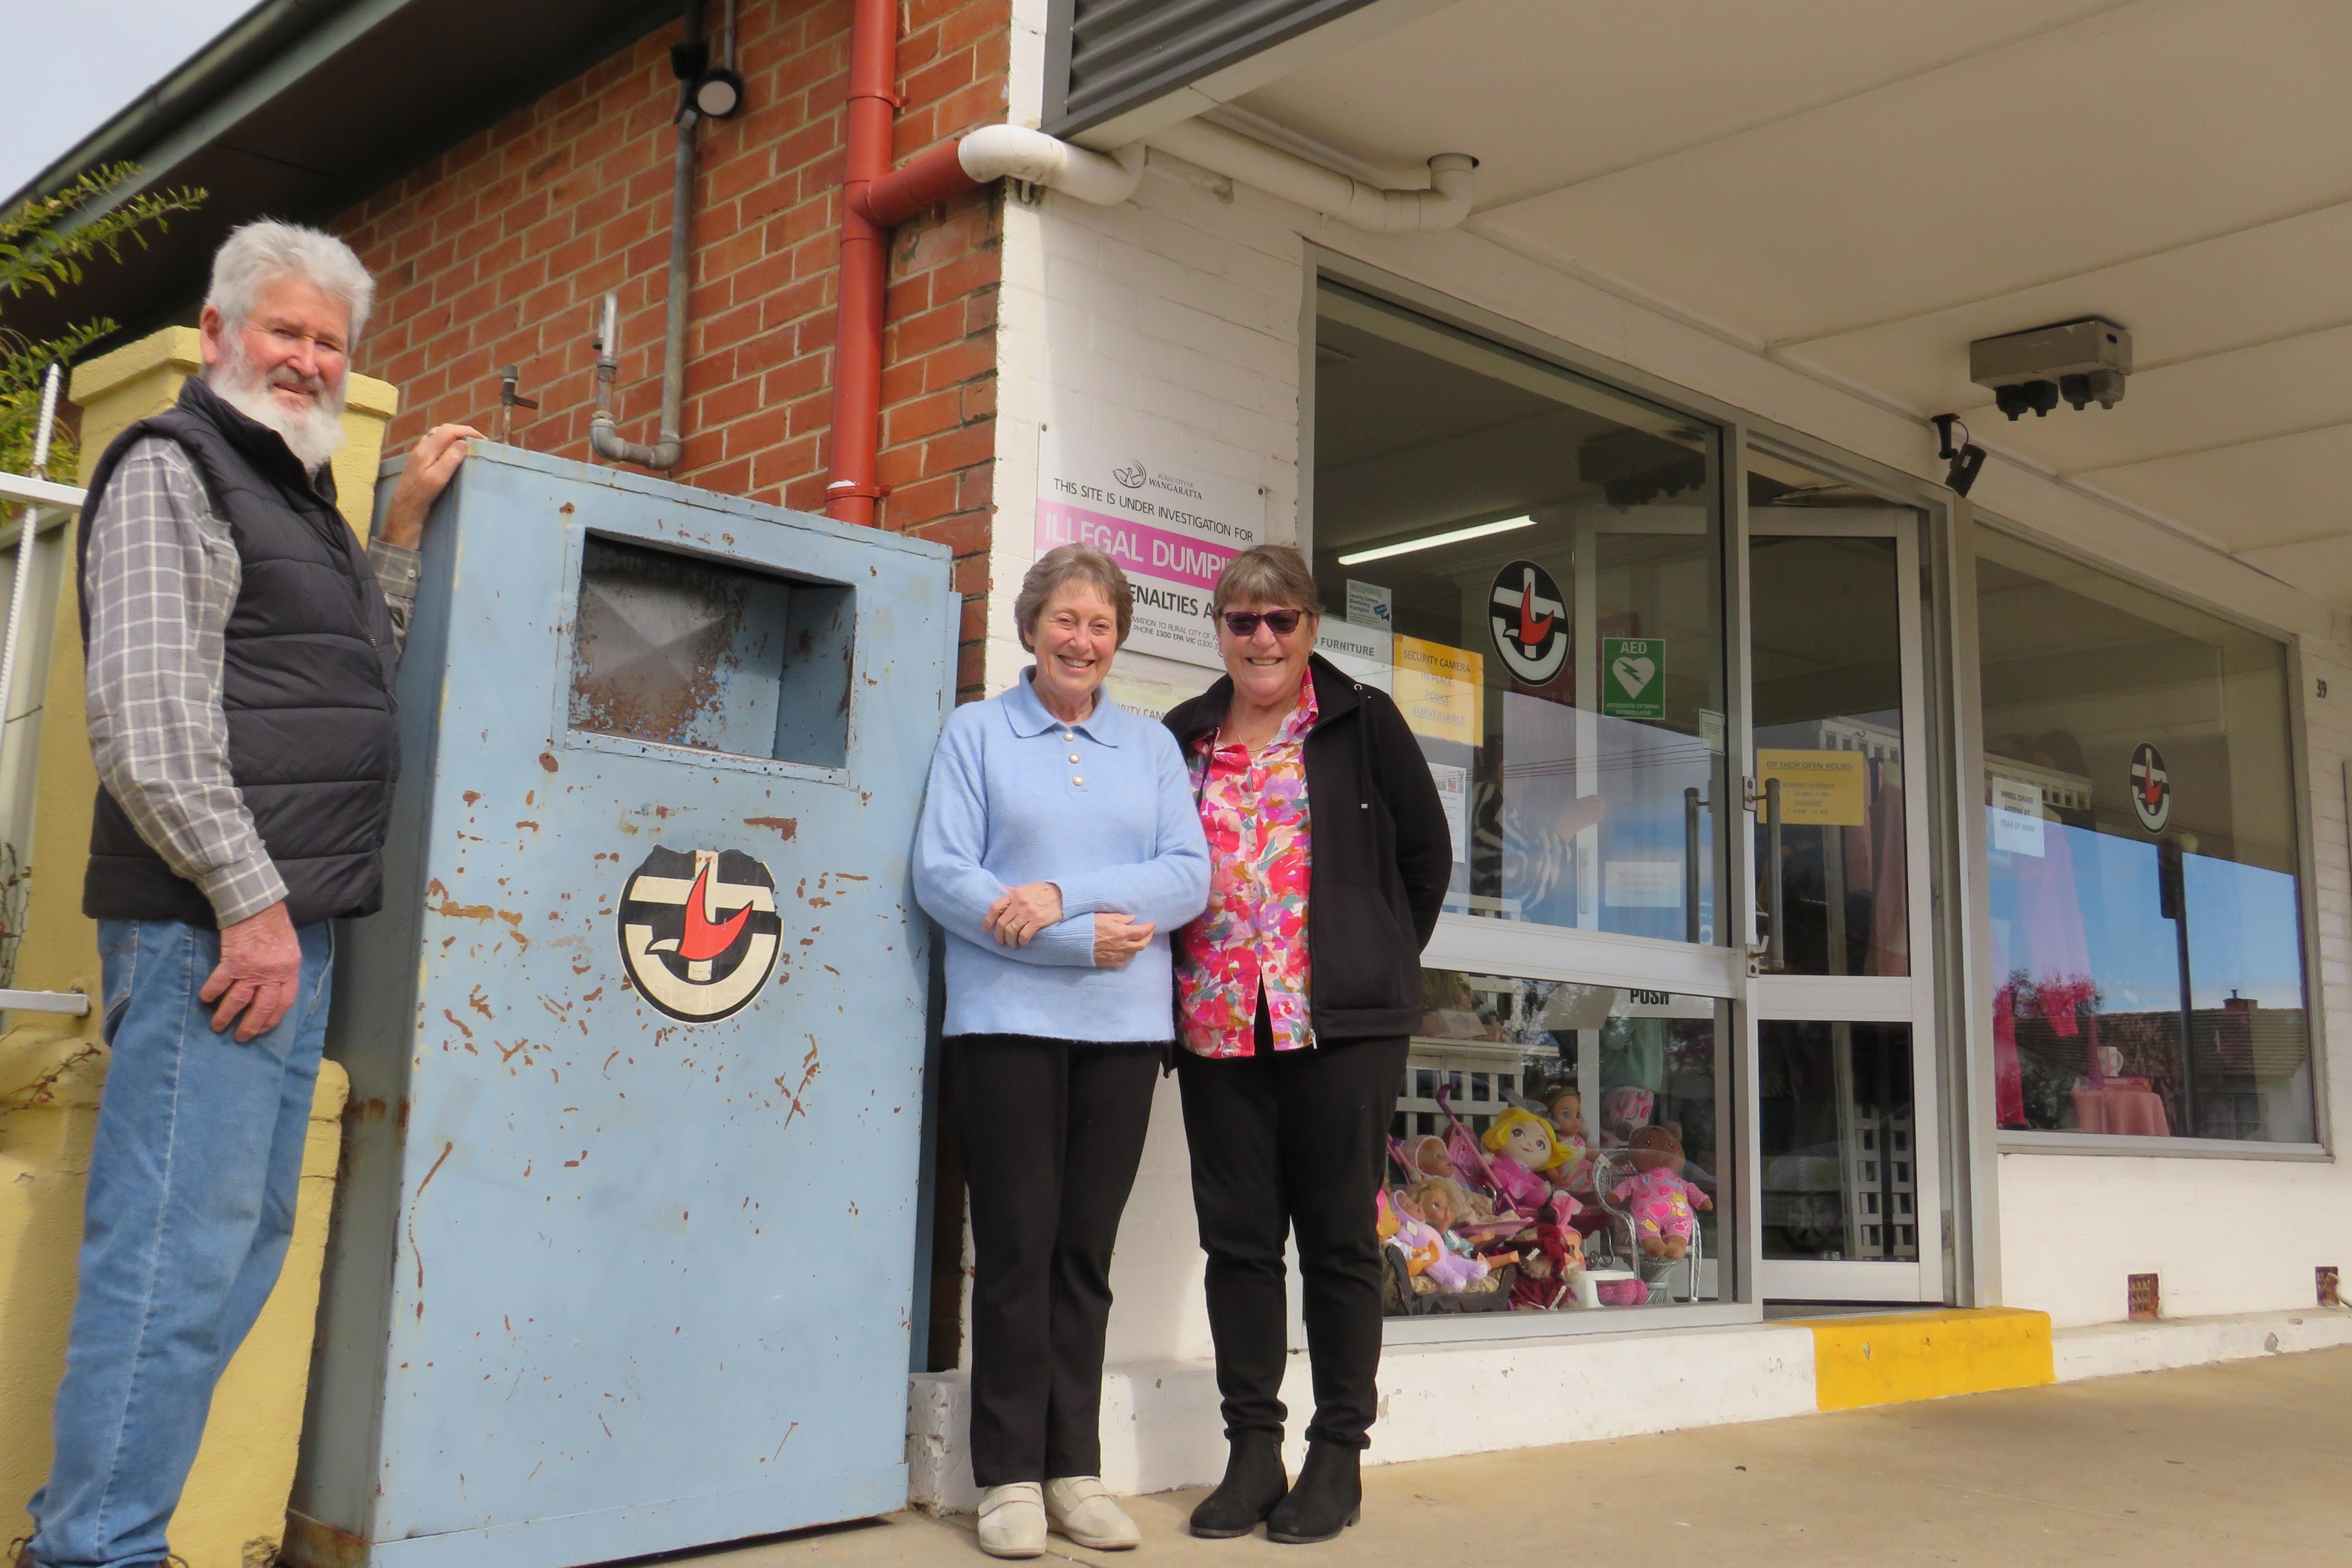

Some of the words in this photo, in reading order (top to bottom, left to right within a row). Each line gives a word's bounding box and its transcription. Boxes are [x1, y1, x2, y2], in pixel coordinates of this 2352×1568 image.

[1149, 477, 1202, 500] WANGARATTA
[1157, 473, 1174, 482] RURAL
[1175, 478, 1187, 486] CITY
[1053, 477, 1077, 494] THIS
[1081, 485, 1102, 501] SITE
[1107, 492, 1115, 505] IS
[1119, 495, 1155, 515] UNDER
[1158, 506, 1230, 536] INVESTIGATION
[1235, 527, 1253, 542] FOR
[1046, 512, 1144, 562] ILLEGAL
[1153, 539, 1230, 579] DUMPI
[1129, 583, 1198, 616] ENALTIES
[1132, 615, 1156, 627] MATION
[1158, 621, 1166, 629] TO
[1168, 624, 1187, 634] RURAL
[1188, 629, 1202, 637] CITY
[1134, 625, 1154, 635] PHONE
[1156, 629, 1171, 638] 1300
[1173, 634, 1184, 642] EPA
[1186, 636, 1196, 644] VIC
[1197, 639, 1213, 648] (1300
[1321, 637, 1375, 657] FURNITURE
[1620, 641, 1647, 654] AED
[1403, 649, 1438, 665] SECURITY
[1440, 658, 1471, 673] CAMERA
[1421, 672, 1429, 681] IN
[1425, 690, 1450, 704] POLICE
[1143, 709, 1167, 721] CAM
[1412, 705, 1465, 724] SURVEILLANCE
[1630, 988, 1669, 1005] PUSH
